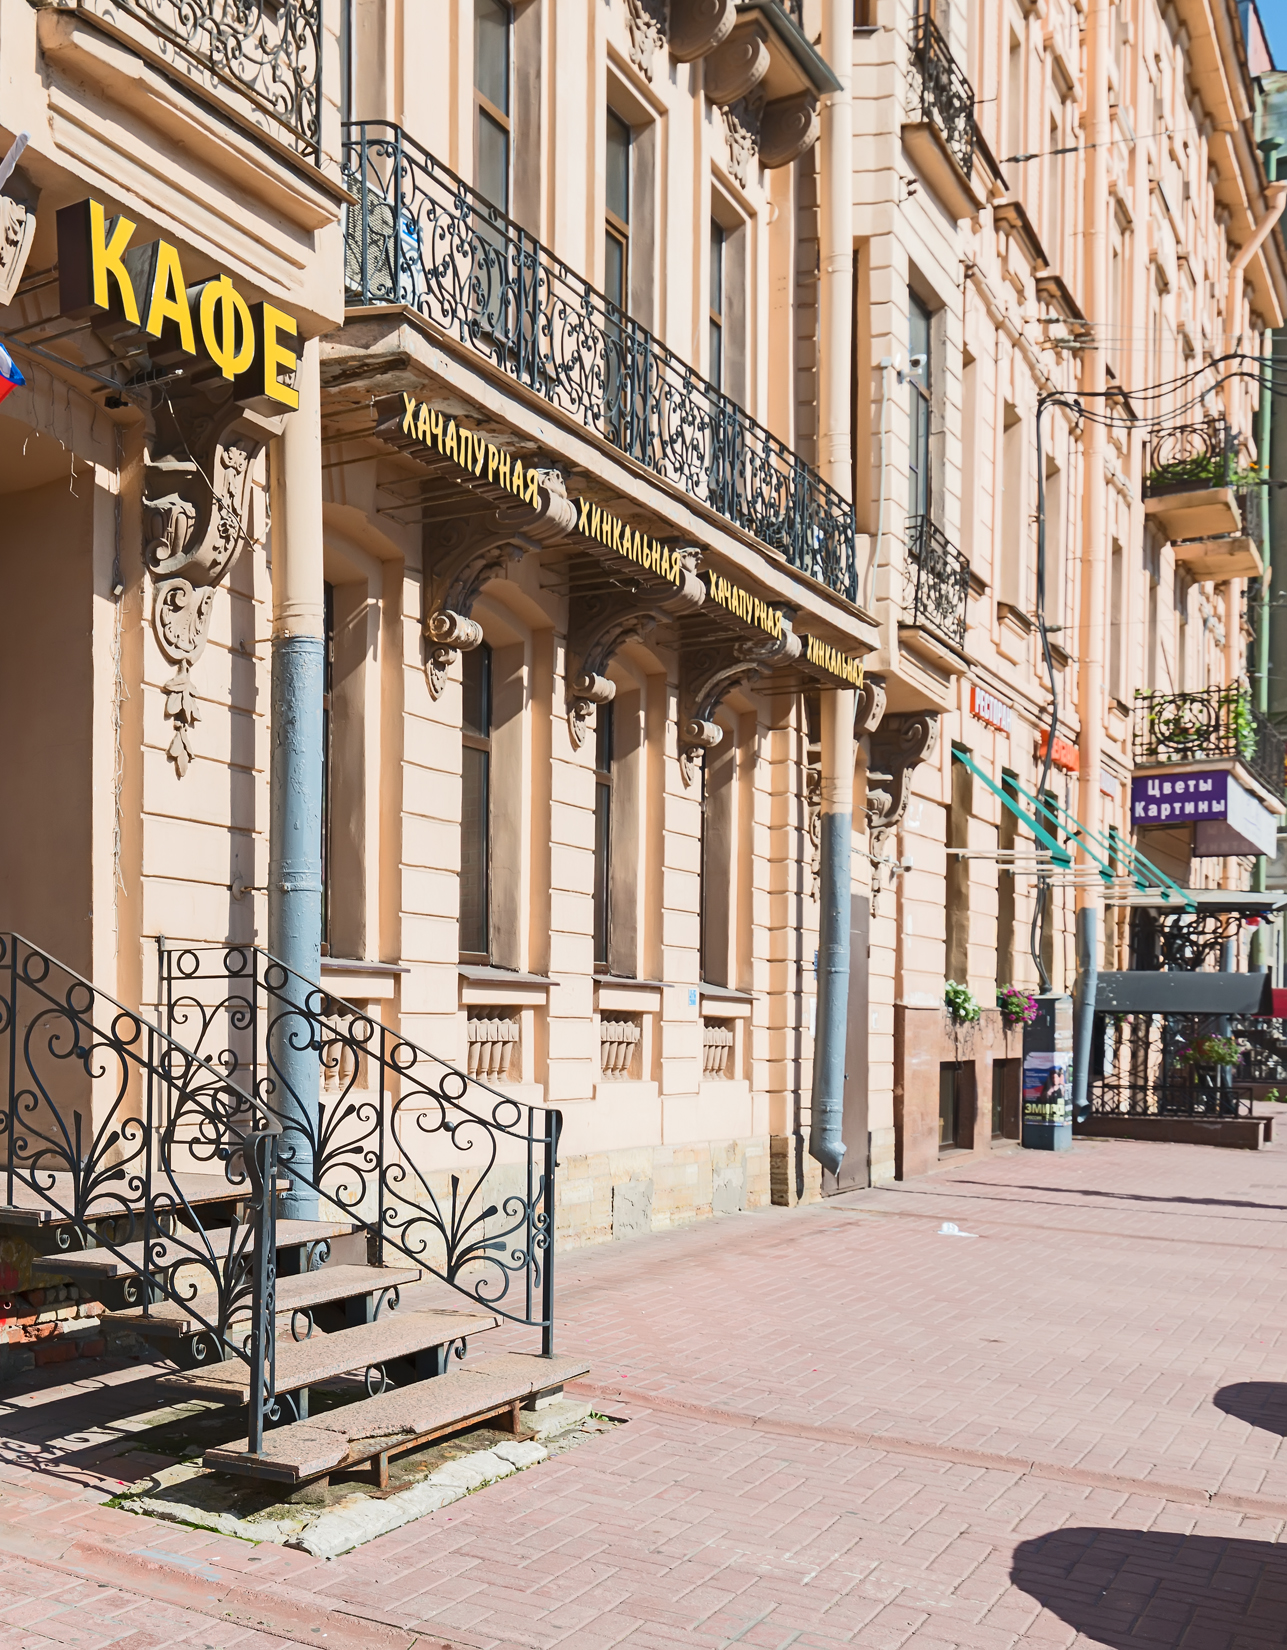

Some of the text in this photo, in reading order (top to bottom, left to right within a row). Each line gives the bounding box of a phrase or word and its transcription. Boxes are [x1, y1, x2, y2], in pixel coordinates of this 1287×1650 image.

[90, 197, 299, 411] КАФЕ
[402, 391, 539, 509] ХАЧАПУРНАЯ
[578, 496, 681, 586] ХИНКАЛЬНАЯ
[709, 568, 782, 640] ХАЧАПУРНАЯ
[807, 633, 863, 689] ХИНКАЛЬНАЯ
[975, 686, 1011, 733] РЕСТОРАН
[1135, 799, 1225, 820] Картины
[1147, 779, 1212, 798] Цветы
